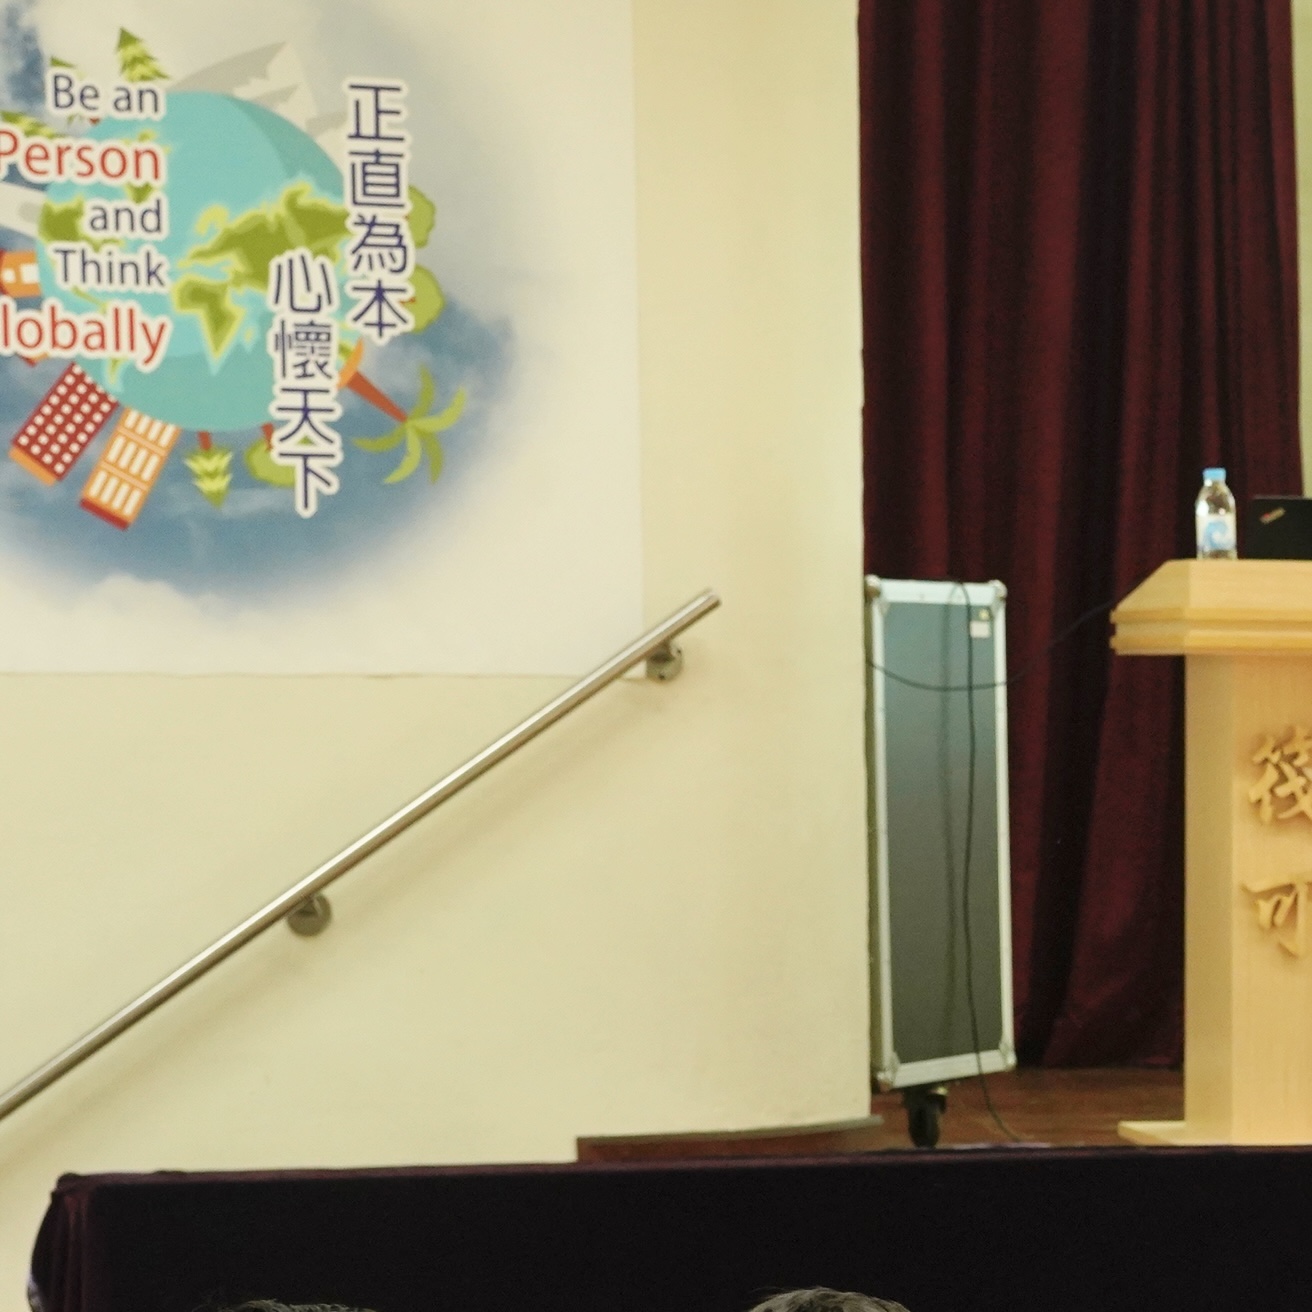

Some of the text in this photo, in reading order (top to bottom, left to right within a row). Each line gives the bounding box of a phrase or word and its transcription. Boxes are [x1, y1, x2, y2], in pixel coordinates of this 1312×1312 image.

[52, 74, 160, 113] Be an
[0, 130, 159, 180] Person
[90, 200, 162, 233] and
[348, 84, 411, 338] 正直為本
[54, 249, 165, 286] Think
[2, 304, 165, 365] lobally
[274, 254, 336, 510] 心懷天下
